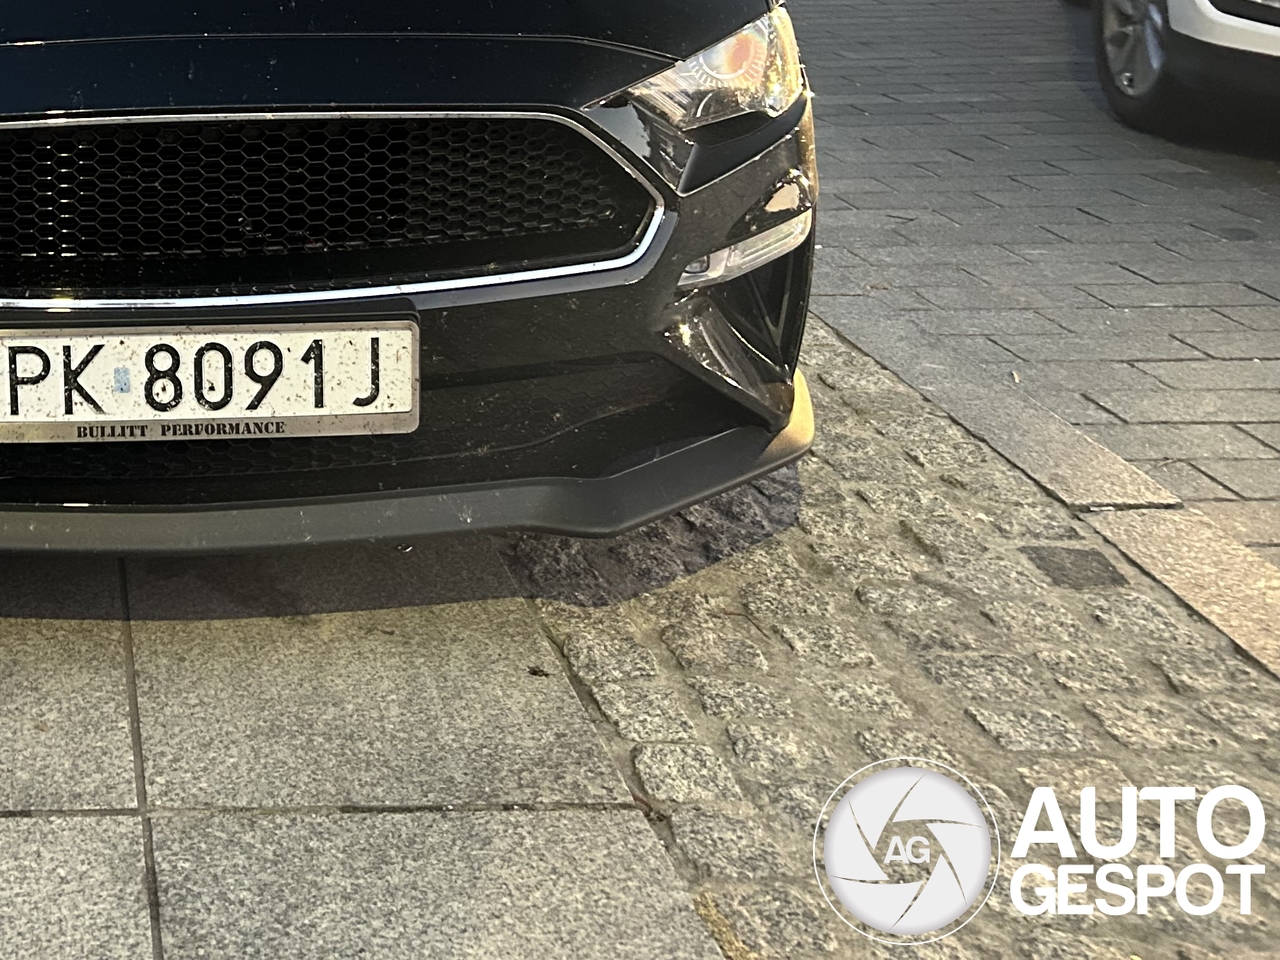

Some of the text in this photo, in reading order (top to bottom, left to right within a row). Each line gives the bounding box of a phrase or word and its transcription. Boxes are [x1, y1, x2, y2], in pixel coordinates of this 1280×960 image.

[7, 343, 106, 416] PK
[143, 337, 380, 413] 8091J
[76, 422, 285, 439] BULLITT PERFORMANCE
